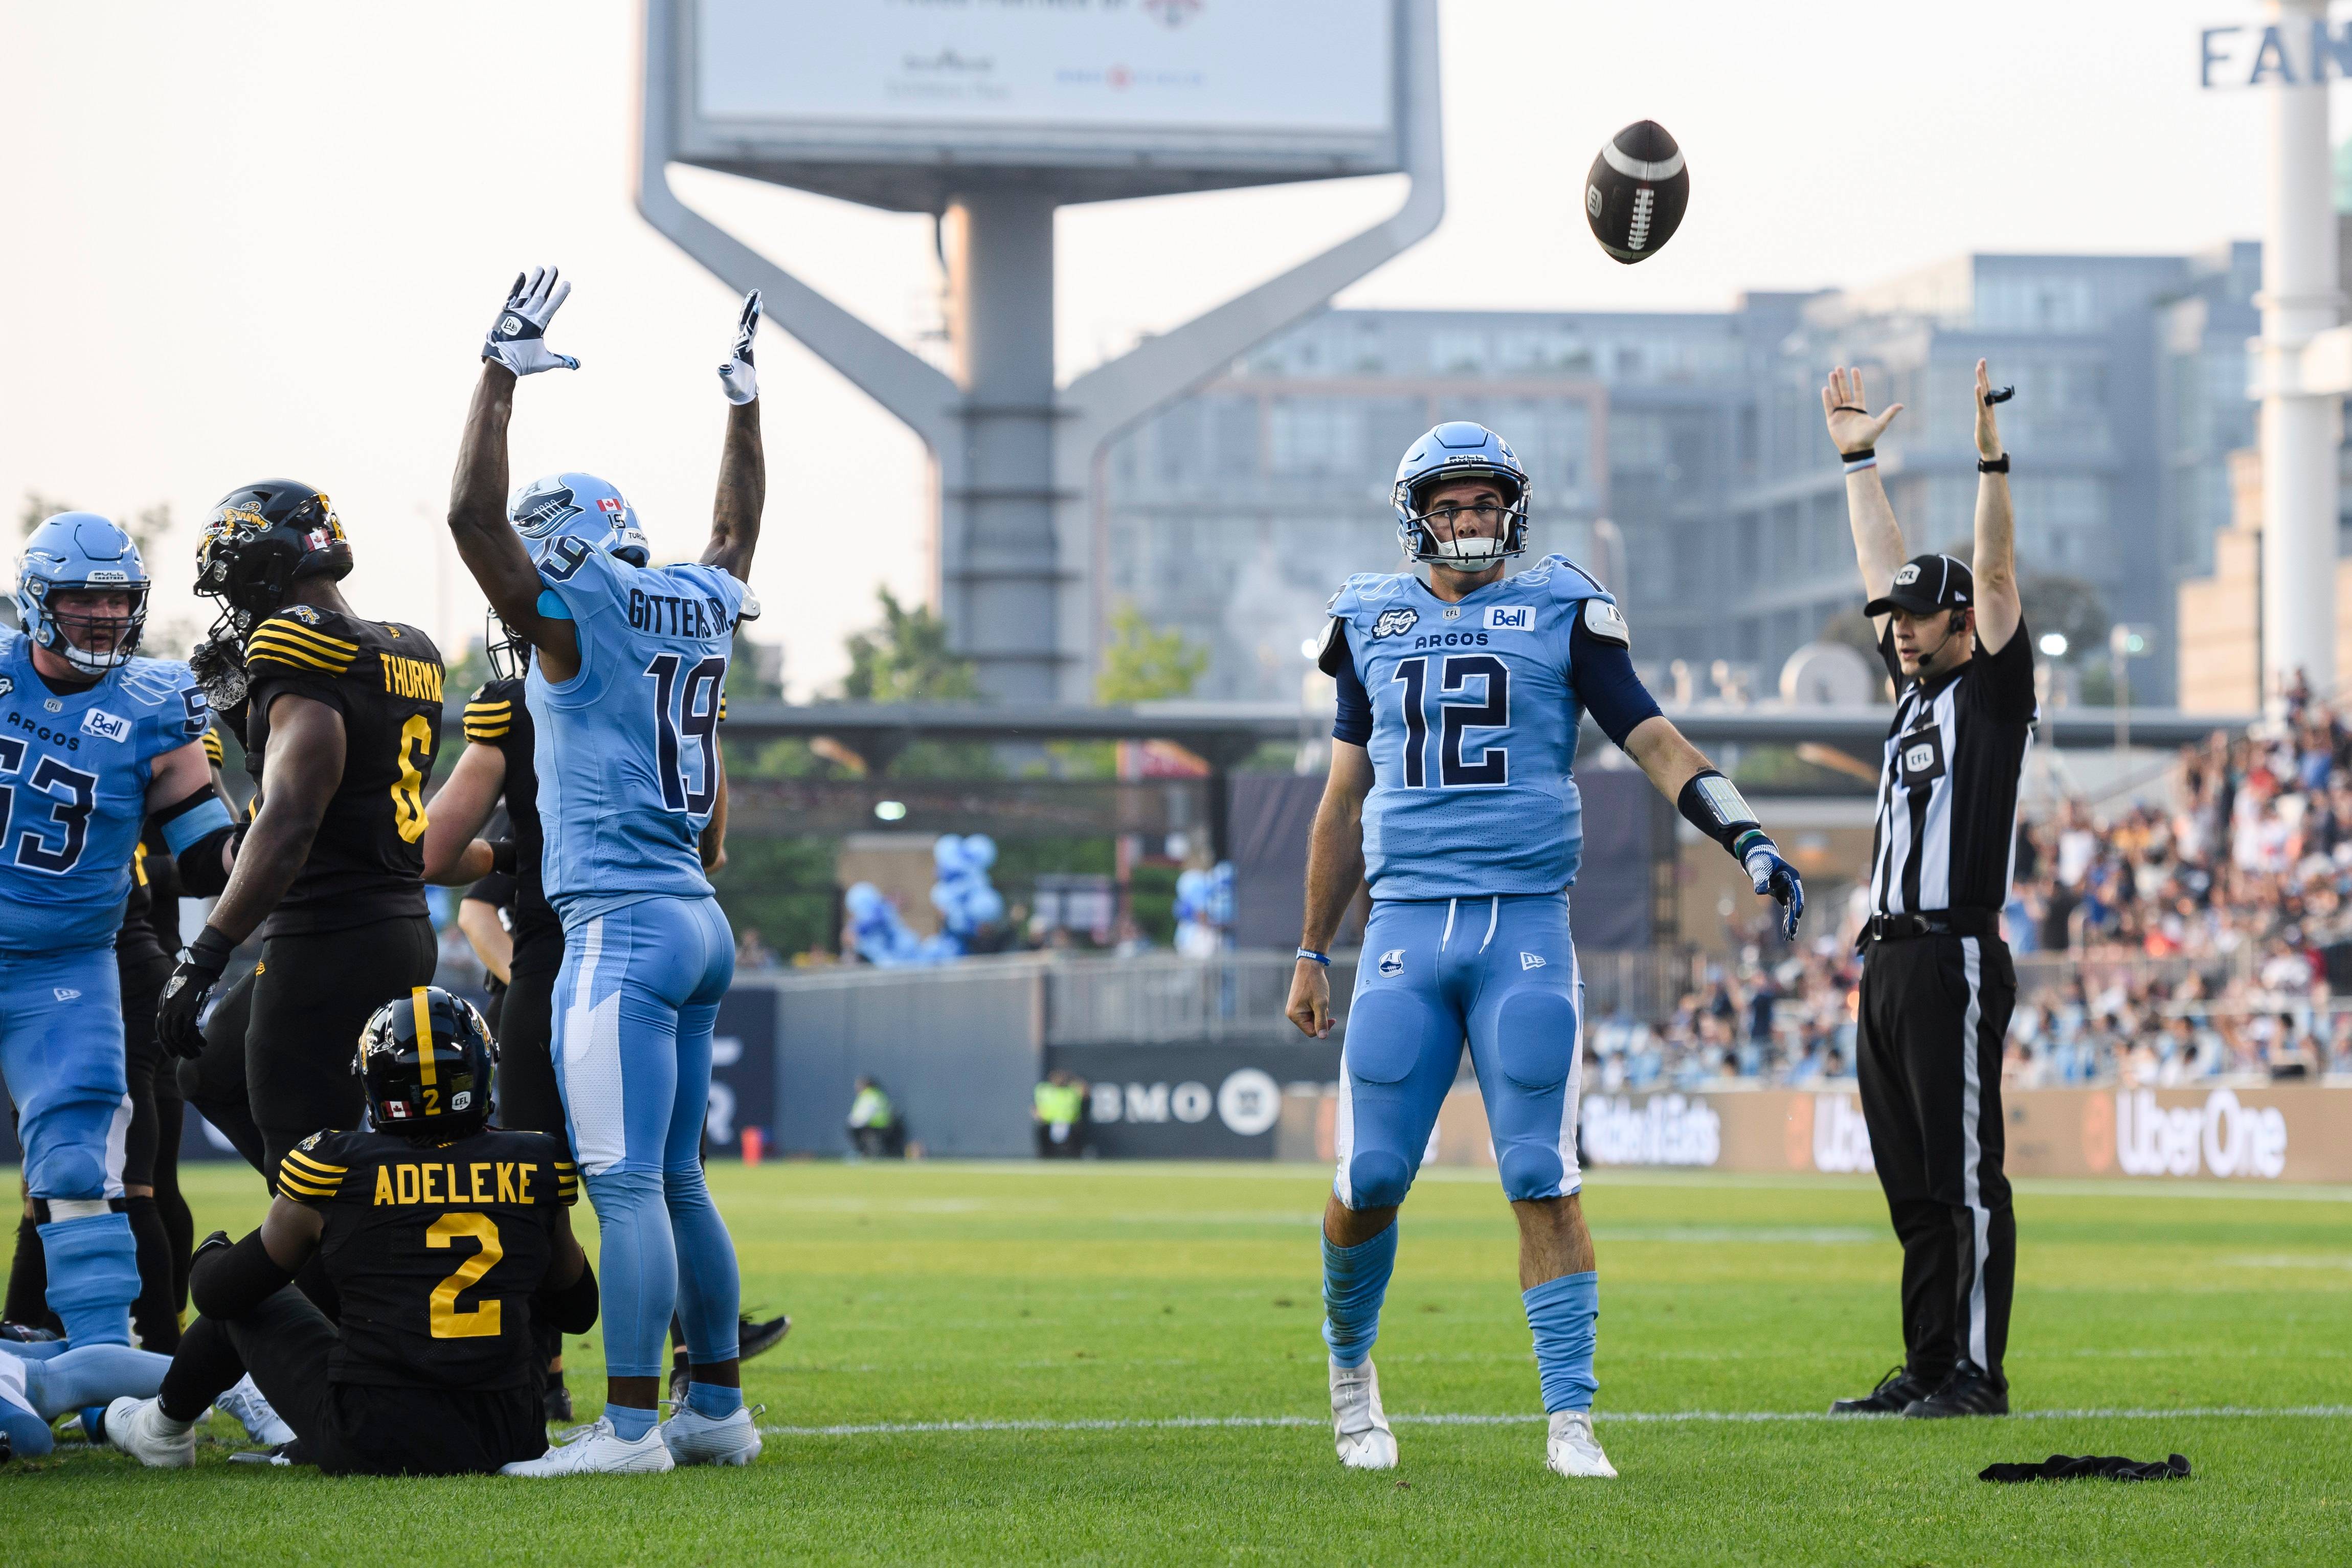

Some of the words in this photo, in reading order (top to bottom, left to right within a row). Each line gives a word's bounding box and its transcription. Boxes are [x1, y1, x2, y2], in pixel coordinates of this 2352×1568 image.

[1493, 609, 1526, 627] Bell
[1415, 632, 1489, 650] ARGOS
[379, 653, 443, 703] THURMA
[47, 701, 58, 710] CFL
[91, 712, 123, 737] Bell
[1391, 653, 1511, 790] 12
[7, 711, 80, 751] ARGOS
[642, 652, 727, 817] 19
[390, 714, 432, 844] 6
[1911, 752, 1929, 766] CFL
[422, 1089, 441, 1116] 2
[455, 1096, 468, 1106] CFL
[1090, 1081, 1213, 1124] BMO
[374, 1162, 537, 1205] ADELEKE
[426, 1212, 503, 1338] 2
